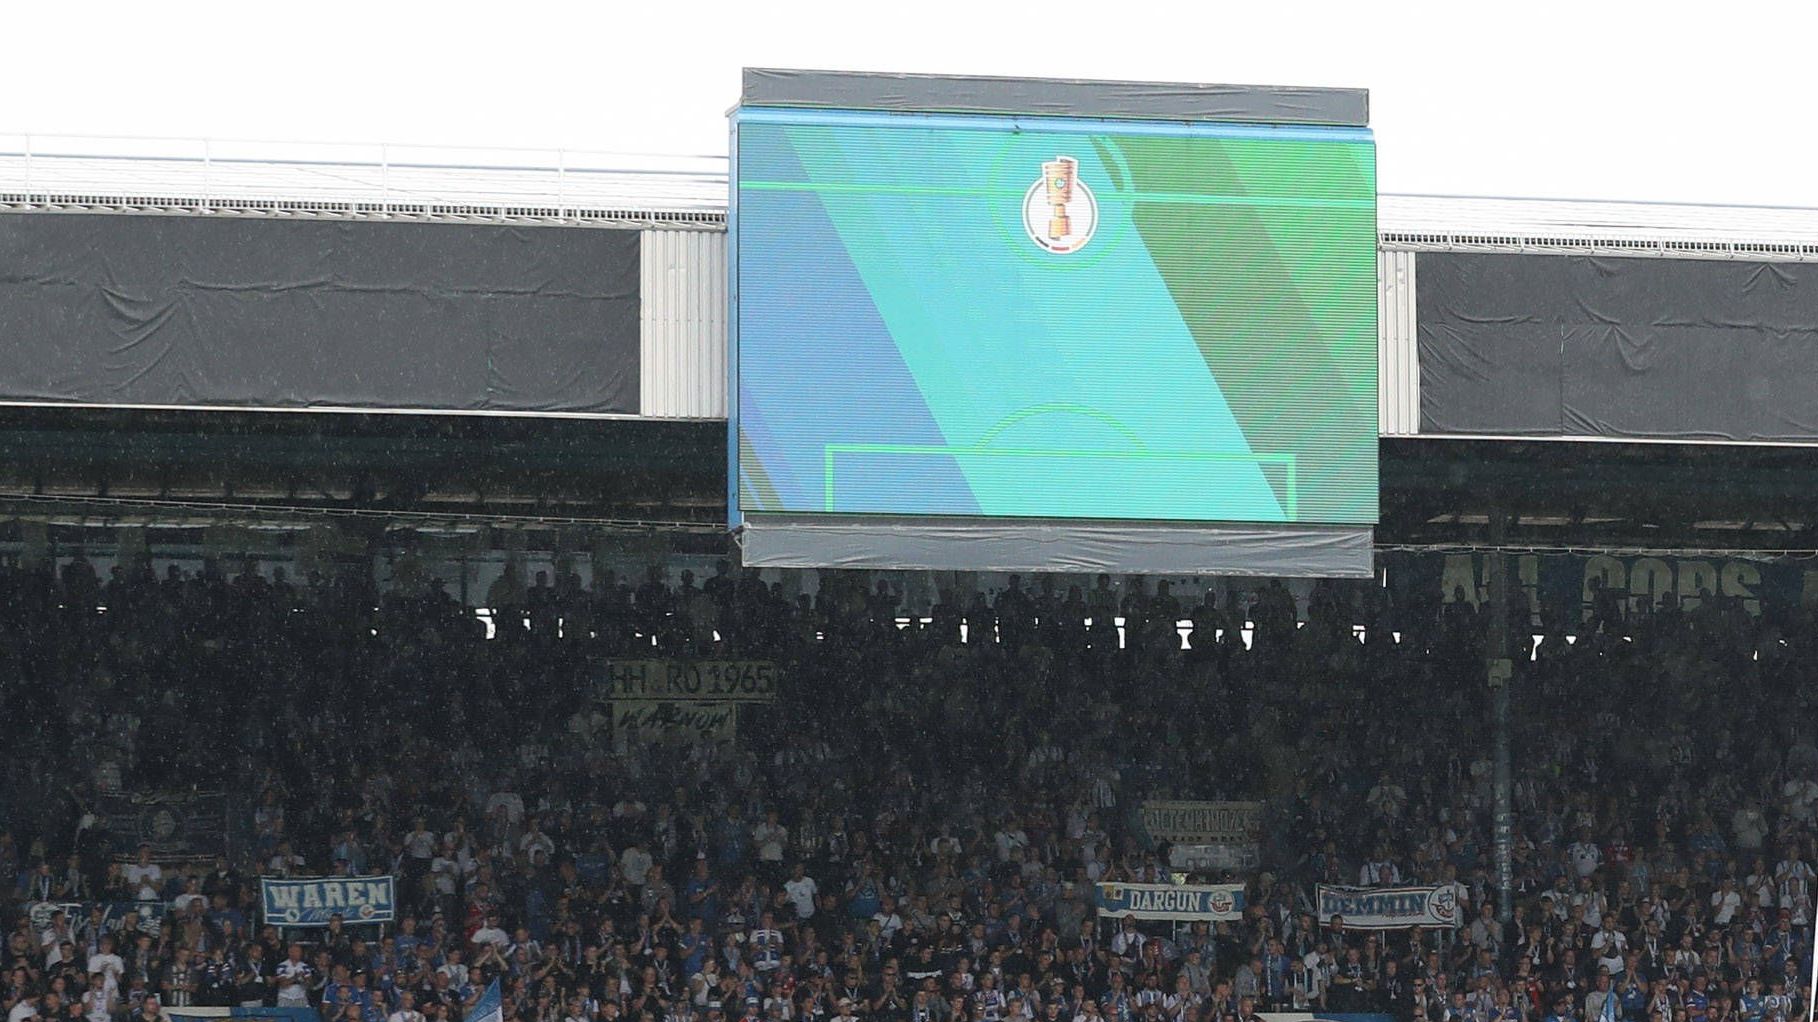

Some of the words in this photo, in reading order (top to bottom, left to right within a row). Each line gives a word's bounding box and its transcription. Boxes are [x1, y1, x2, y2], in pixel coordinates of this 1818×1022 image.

[706, 664, 773, 694] 1965
[268, 882, 389, 909] WAREN
[1129, 890, 1202, 913] DARGUN
